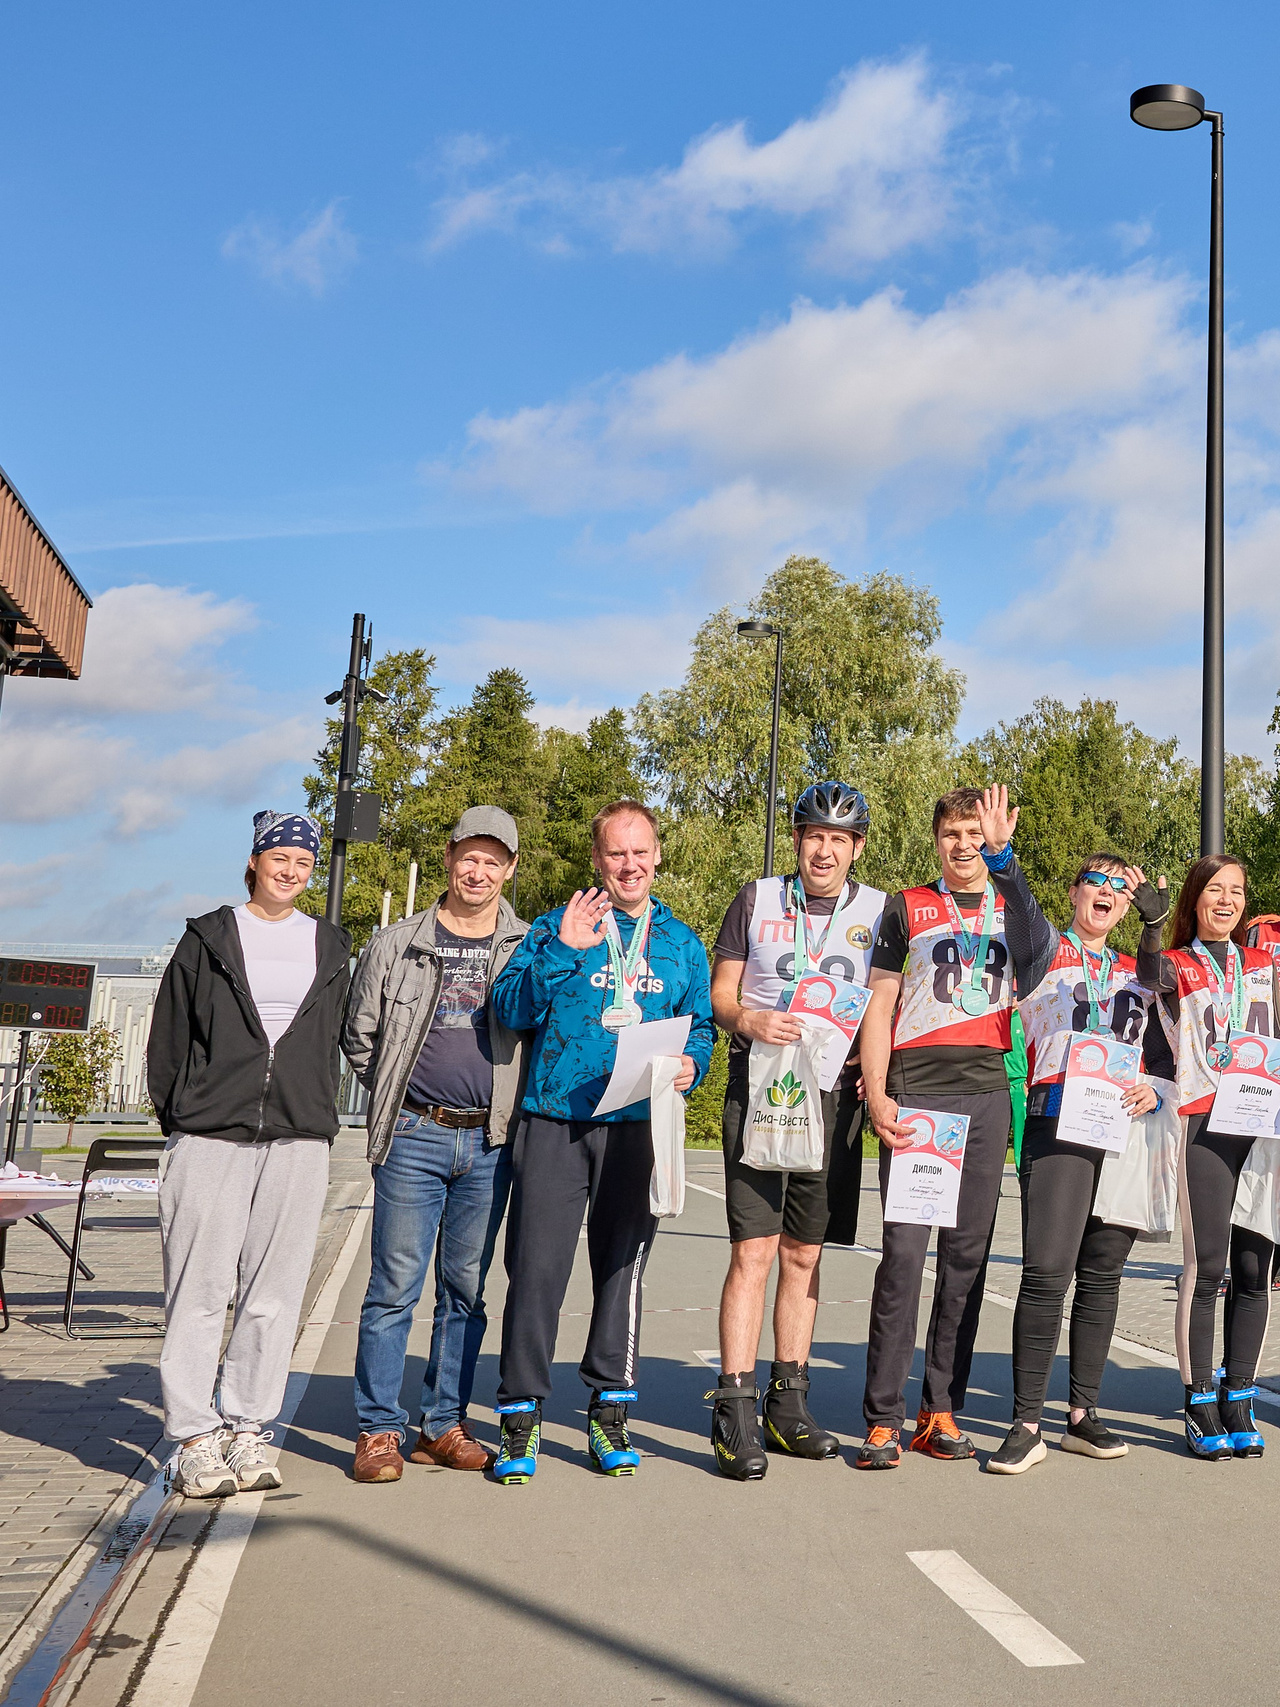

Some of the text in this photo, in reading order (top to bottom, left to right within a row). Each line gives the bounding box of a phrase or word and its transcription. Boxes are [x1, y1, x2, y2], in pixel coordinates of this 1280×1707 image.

[914, 906, 939, 923] ГТО
[932, 939, 1007, 1004] 83
[590, 972, 664, 994] adas
[43, 1005, 83, 1027] 002
[1072, 981, 1144, 1045] 86
[1084, 1087, 1116, 1101] ДИПЛОМ
[1239, 1084, 1272, 1096] ДИПЛОМ
[912, 1164, 942, 1175] ДИПЛОМ
